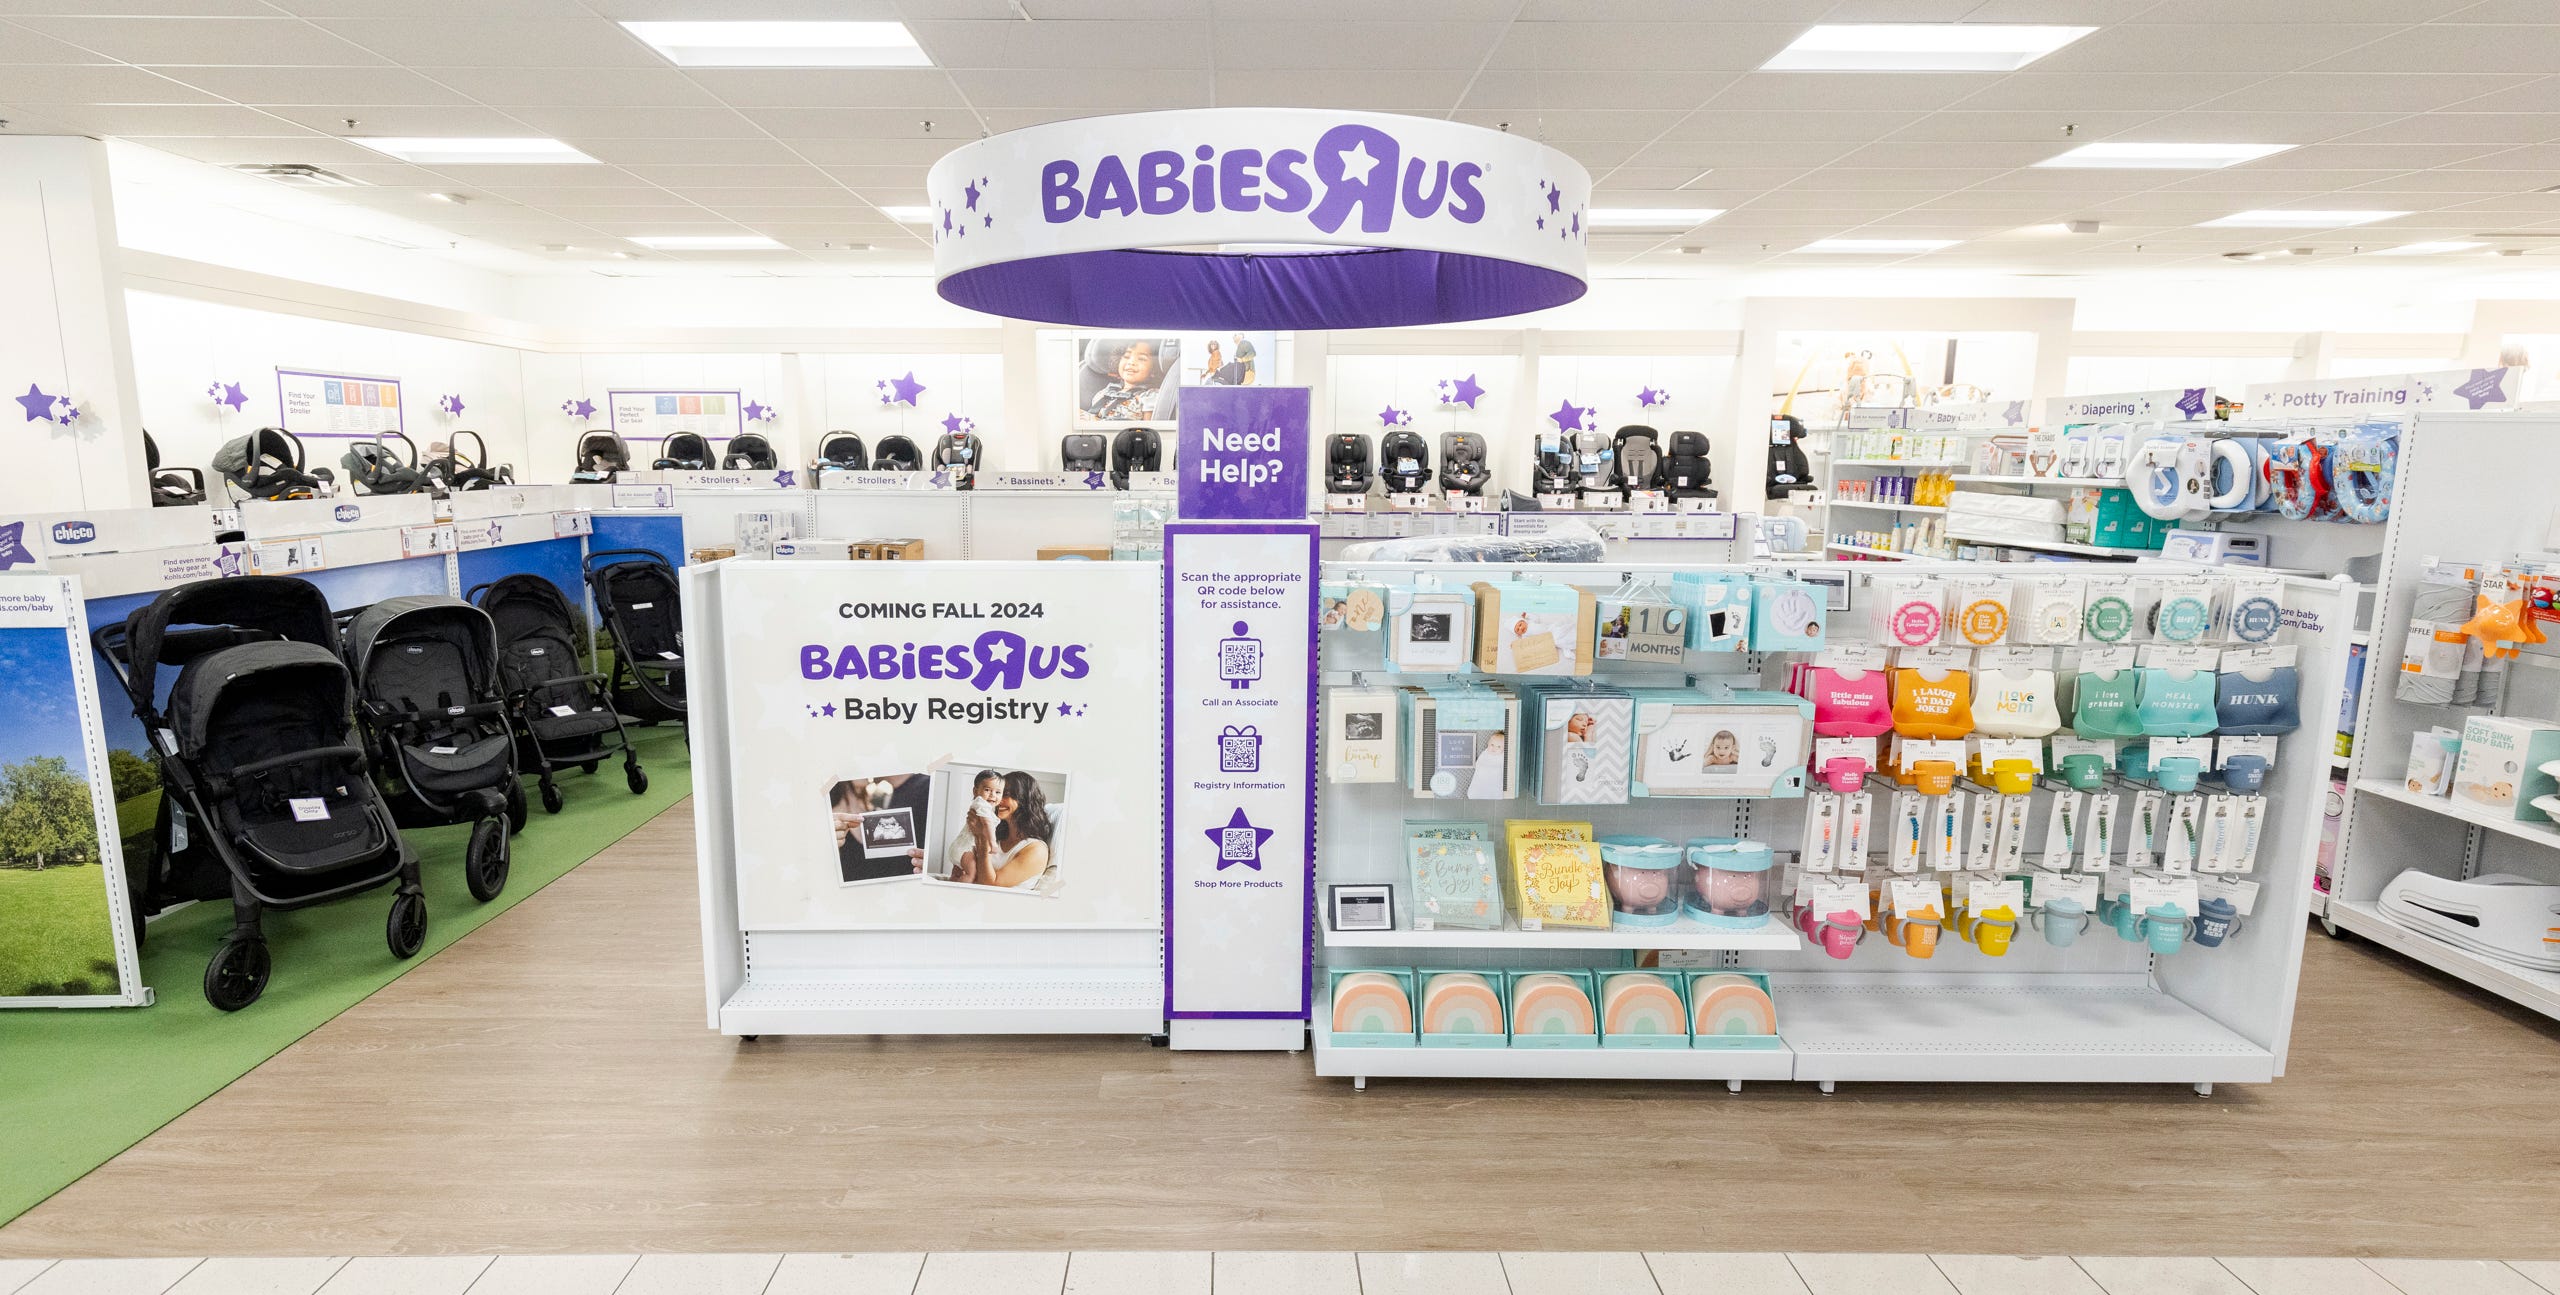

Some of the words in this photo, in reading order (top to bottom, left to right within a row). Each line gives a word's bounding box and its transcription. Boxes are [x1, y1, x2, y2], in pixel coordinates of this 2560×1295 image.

[2282, 393, 2327, 408] Potty
[2333, 388, 2407, 405] Training
[2081, 402, 2136, 416] Diapering
[1937, 413, 1956, 424] Baby
[1203, 427, 1281, 452] Need
[1201, 458, 1284, 487] Help?
[700, 476, 740, 484] Strollers
[857, 475, 897, 485] Strollers
[1010, 477, 1054, 486] Bassinets
[55, 522, 94, 541] chicco
[163, 558, 178, 566] Find
[168, 565, 185, 574] baby
[186, 565, 199, 573] gear
[164, 570, 213, 582] Kohls.com/baby
[1181, 572, 1208, 582] Scan
[1212, 572, 1231, 582] the
[1233, 572, 1302, 583] appropriate
[2483, 579, 2504, 589] STAR
[1197, 586, 1215, 596] QR
[1218, 586, 1247, 595] code
[1250, 586, 1285, 595] below
[24, 594, 46, 603] baby
[1201, 599, 1217, 609] for
[1220, 600, 1281, 609] assistance.
[838, 602, 927, 618] COMING
[932, 603, 985, 618] FALL
[989, 603, 1044, 618] 2024
[2296, 610, 2320, 622] baby
[1630, 643, 1681, 656] MONTHS
[1912, 689, 1918, 697] I
[1919, 687, 1957, 700] LAUGH
[1202, 698, 1219, 706] Call
[1235, 698, 1278, 706] Associate
[1930, 698, 1953, 706] DAD
[2088, 701, 2124, 709] grandma
[2229, 694, 2280, 706] HUNK
[844, 697, 918, 724] Baby
[928, 697, 1050, 724] Registry
[1915, 704, 1950, 714] JOKES
[2151, 702, 2201, 711] MONSTER
[2466, 726, 2490, 738] SOFT
[2491, 731, 2514, 743] SINK
[2465, 734, 2489, 745] BABY
[2490, 739, 2515, 751] BATH
[1194, 781, 1231, 790] Registry
[1233, 781, 1286, 790] Information
[1435, 861, 1473, 879] Bump
[1538, 862, 1583, 878] Bundle
[1194, 880, 1217, 889] Shop
[1219, 880, 1242, 888] More
[1243, 880, 1284, 888] Products
[1549, 875, 1580, 894] Joy!
